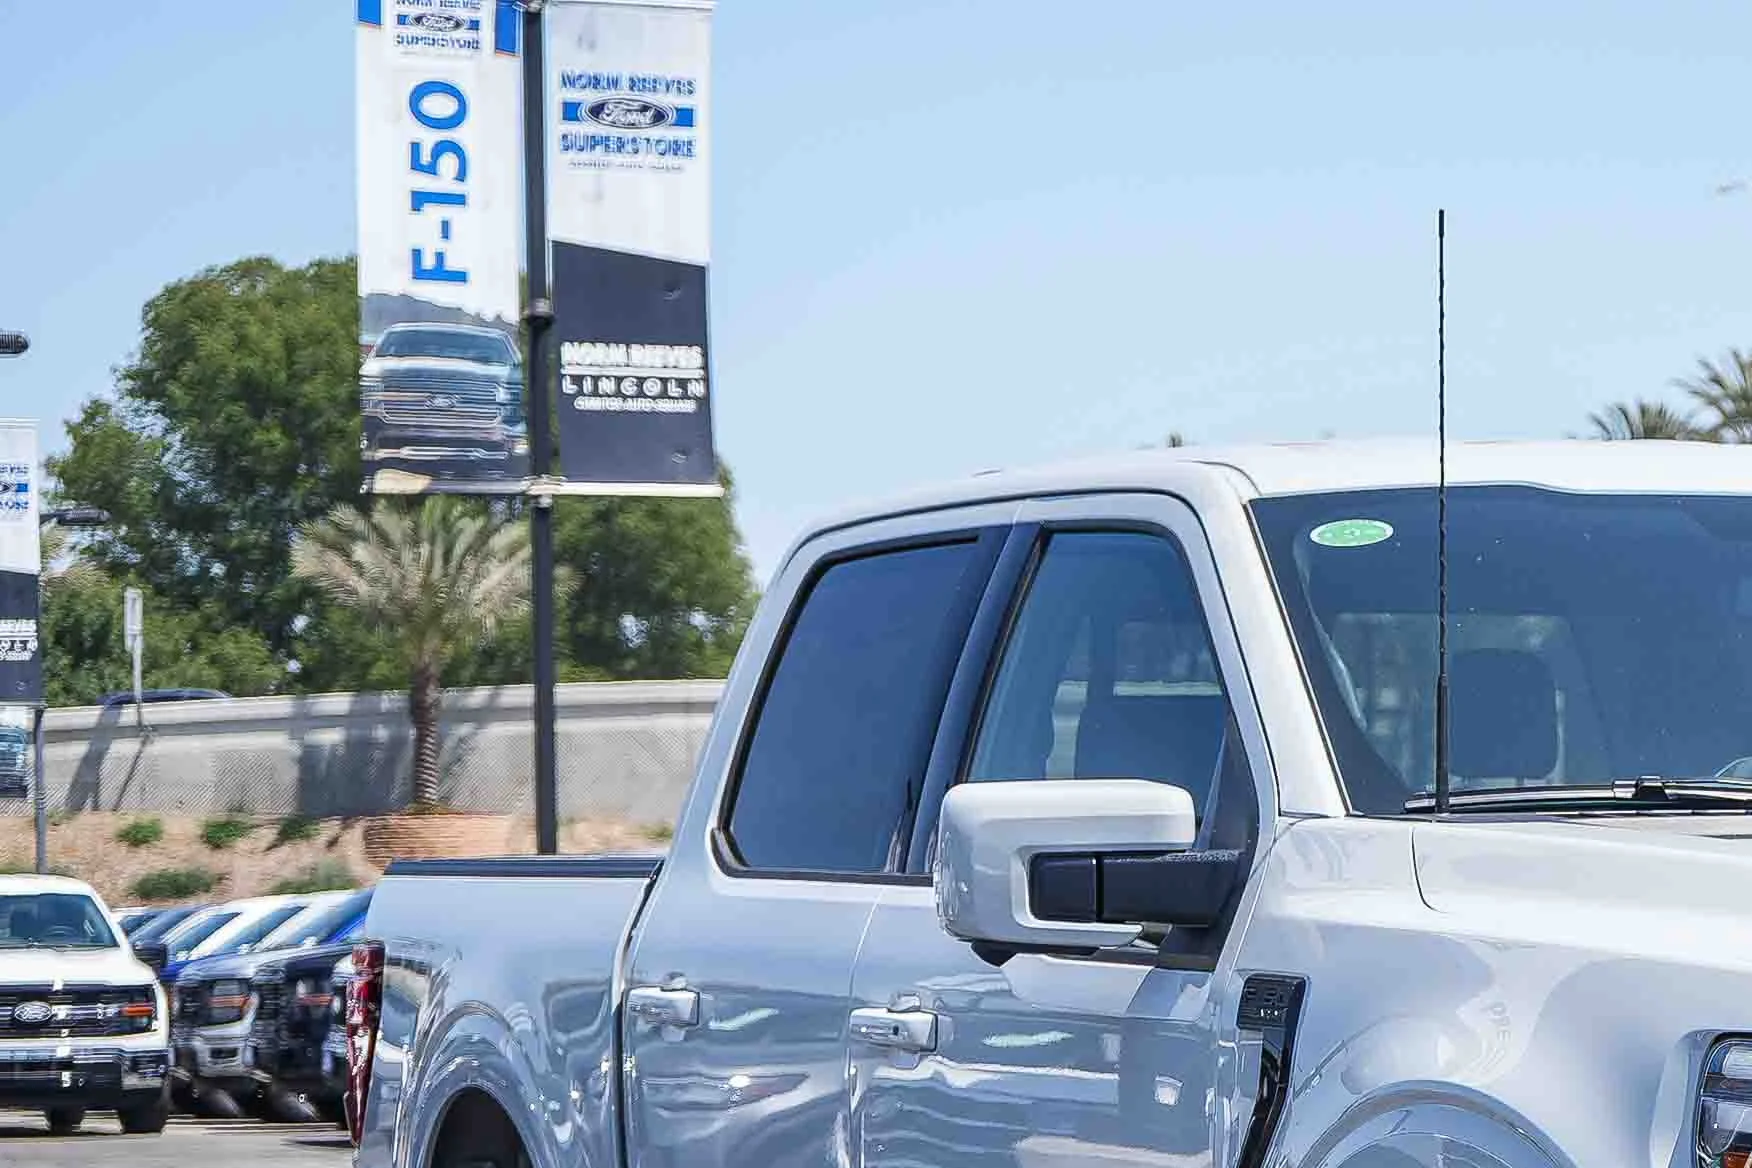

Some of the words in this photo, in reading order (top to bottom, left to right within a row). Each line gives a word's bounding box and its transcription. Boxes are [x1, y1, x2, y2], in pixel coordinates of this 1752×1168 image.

[561, 133, 694, 157] SUPERSTORE
[409, 80, 467, 283] F-150
[561, 375, 705, 398] LINCOLN
